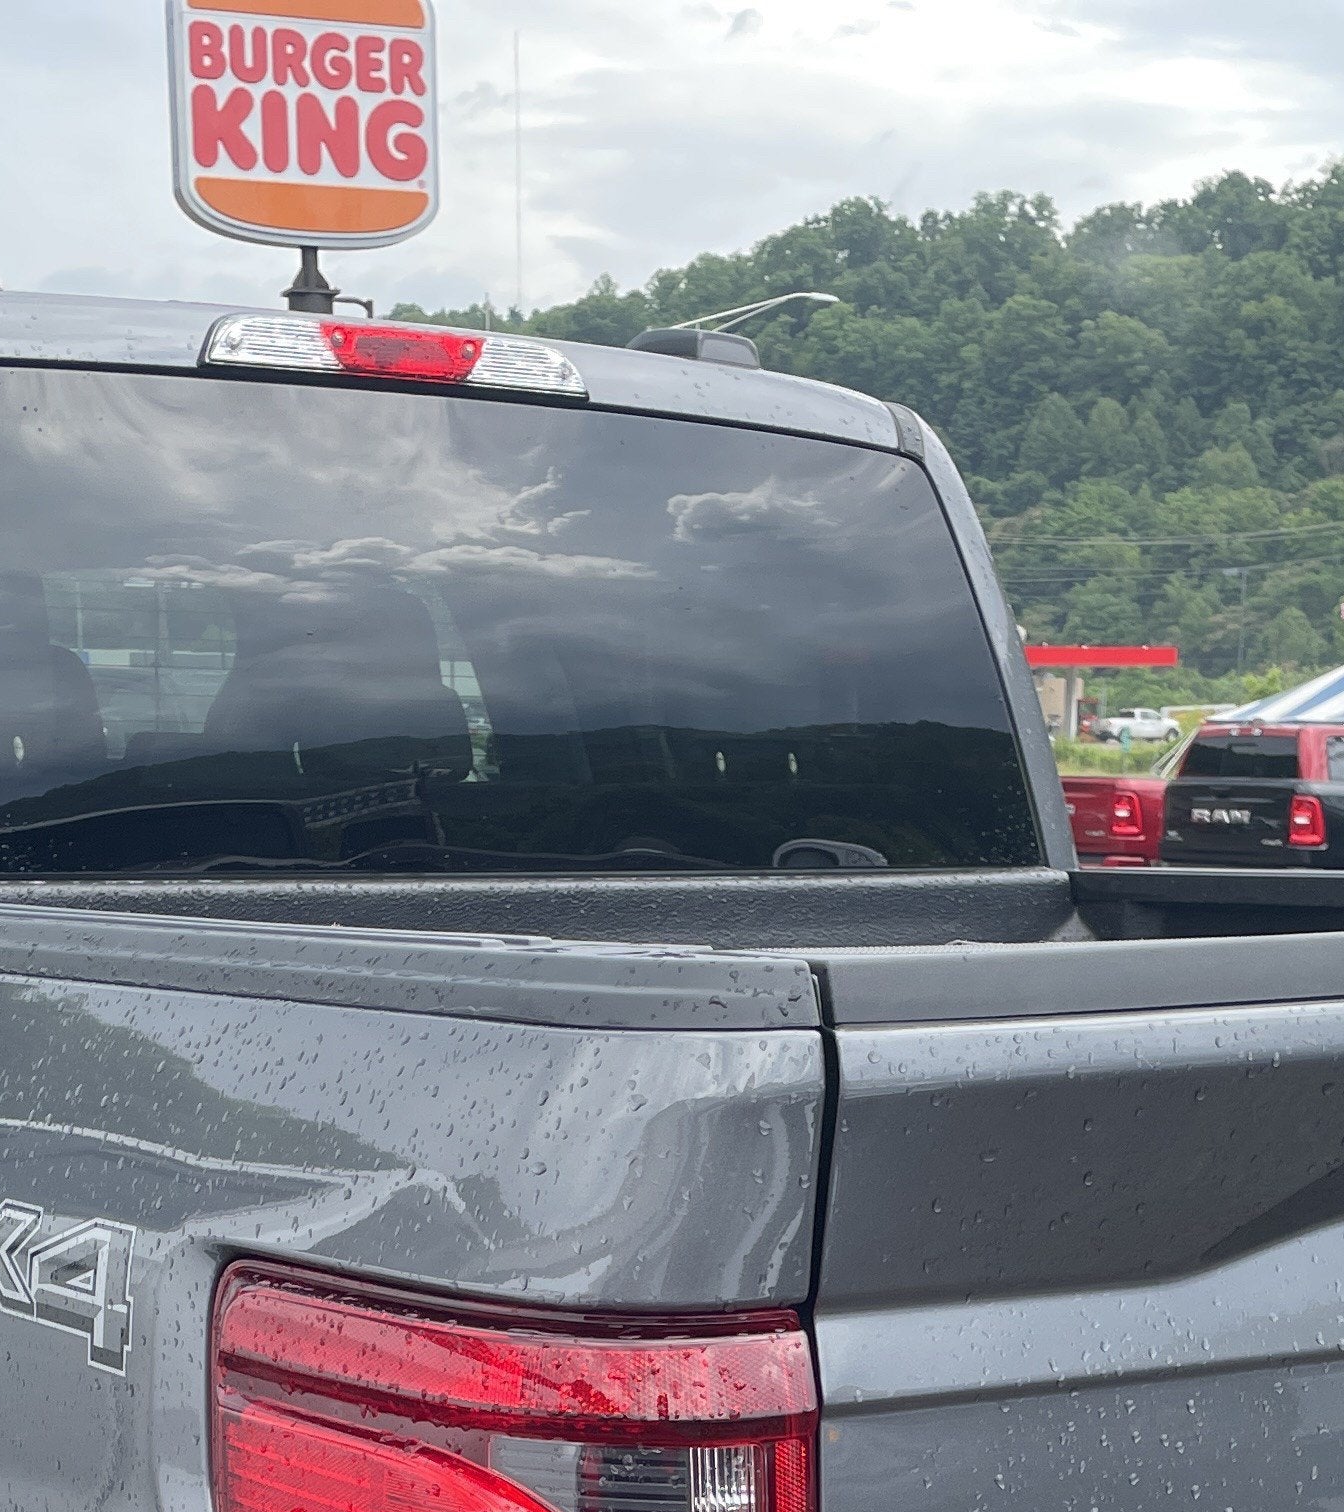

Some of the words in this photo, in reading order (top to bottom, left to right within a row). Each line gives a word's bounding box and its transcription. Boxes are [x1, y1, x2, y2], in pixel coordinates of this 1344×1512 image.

[188, 20, 427, 96] BURGER
[190, 84, 428, 181] KING
[1190, 808, 1251, 824] RAM
